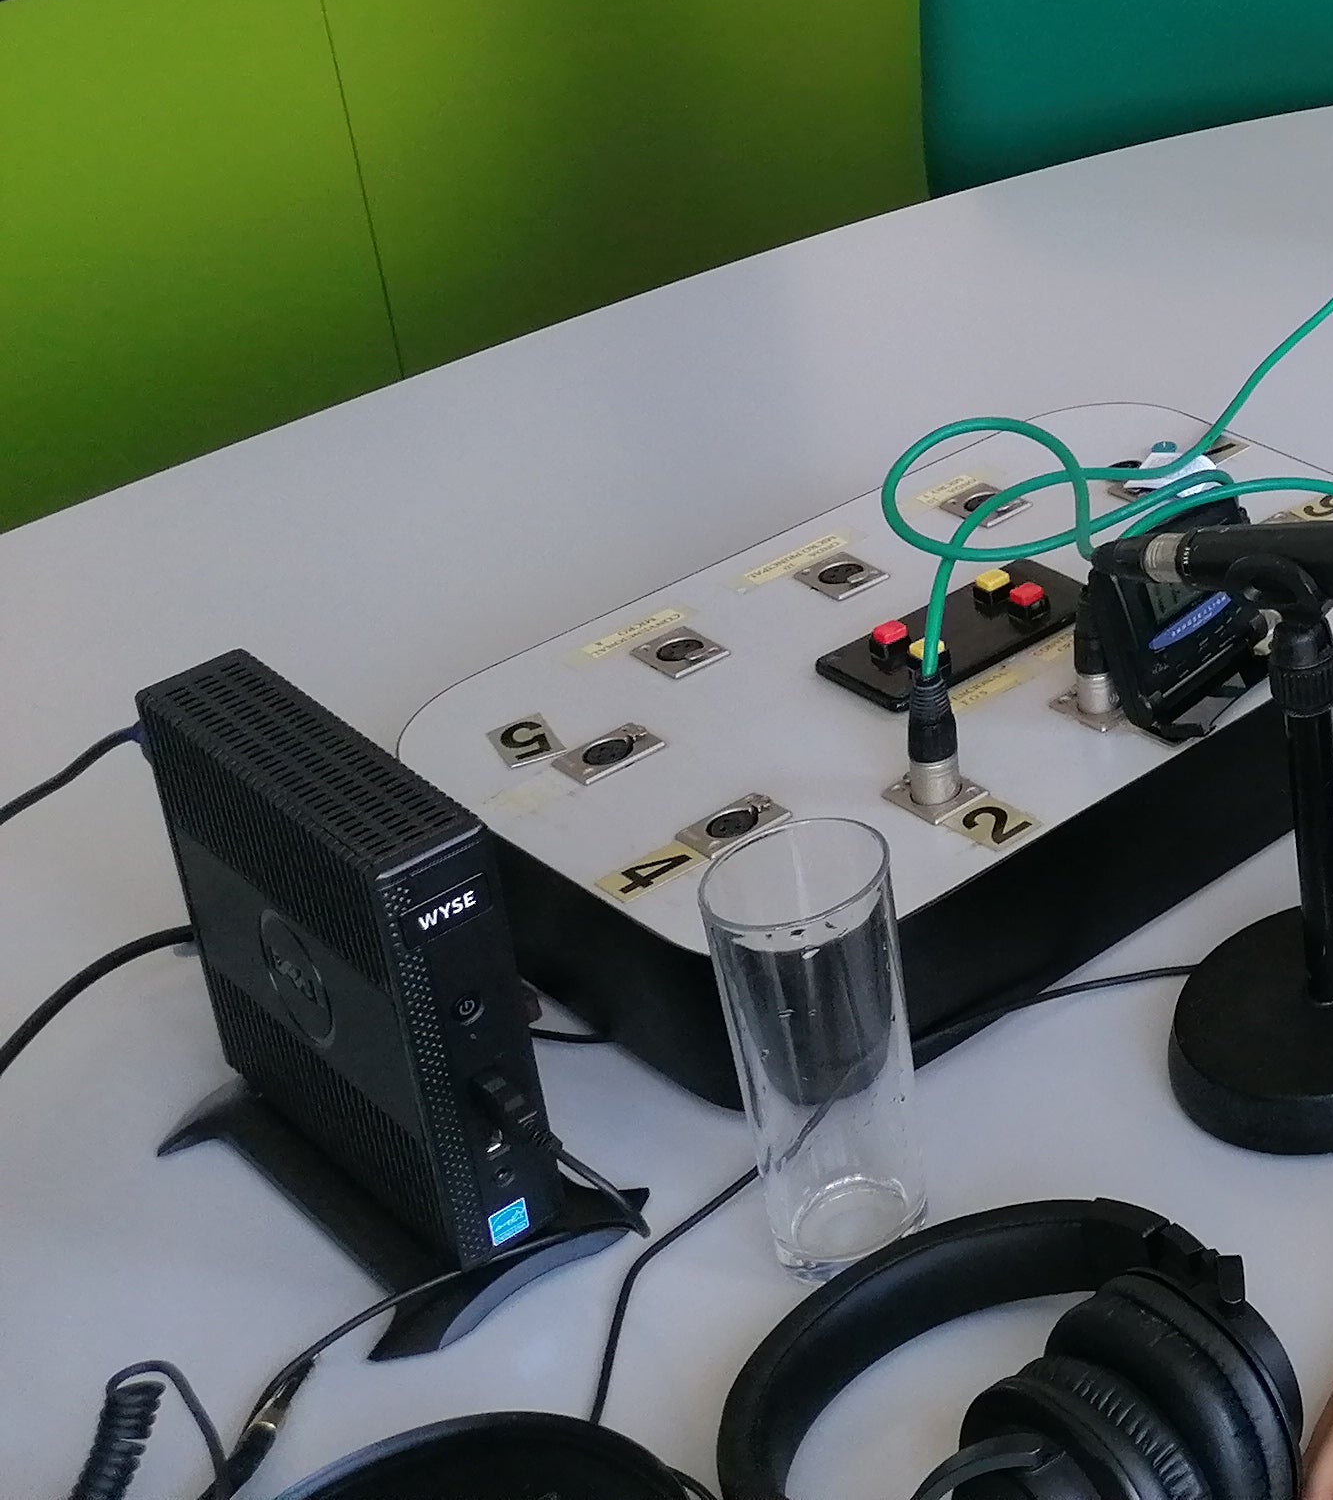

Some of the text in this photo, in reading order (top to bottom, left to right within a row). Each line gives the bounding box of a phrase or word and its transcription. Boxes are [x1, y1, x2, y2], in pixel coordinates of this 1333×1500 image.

[500, 721, 552, 761] 5
[962, 806, 1033, 845] 2
[618, 853, 693, 894] 4
[417, 890, 477, 931] WYSE
